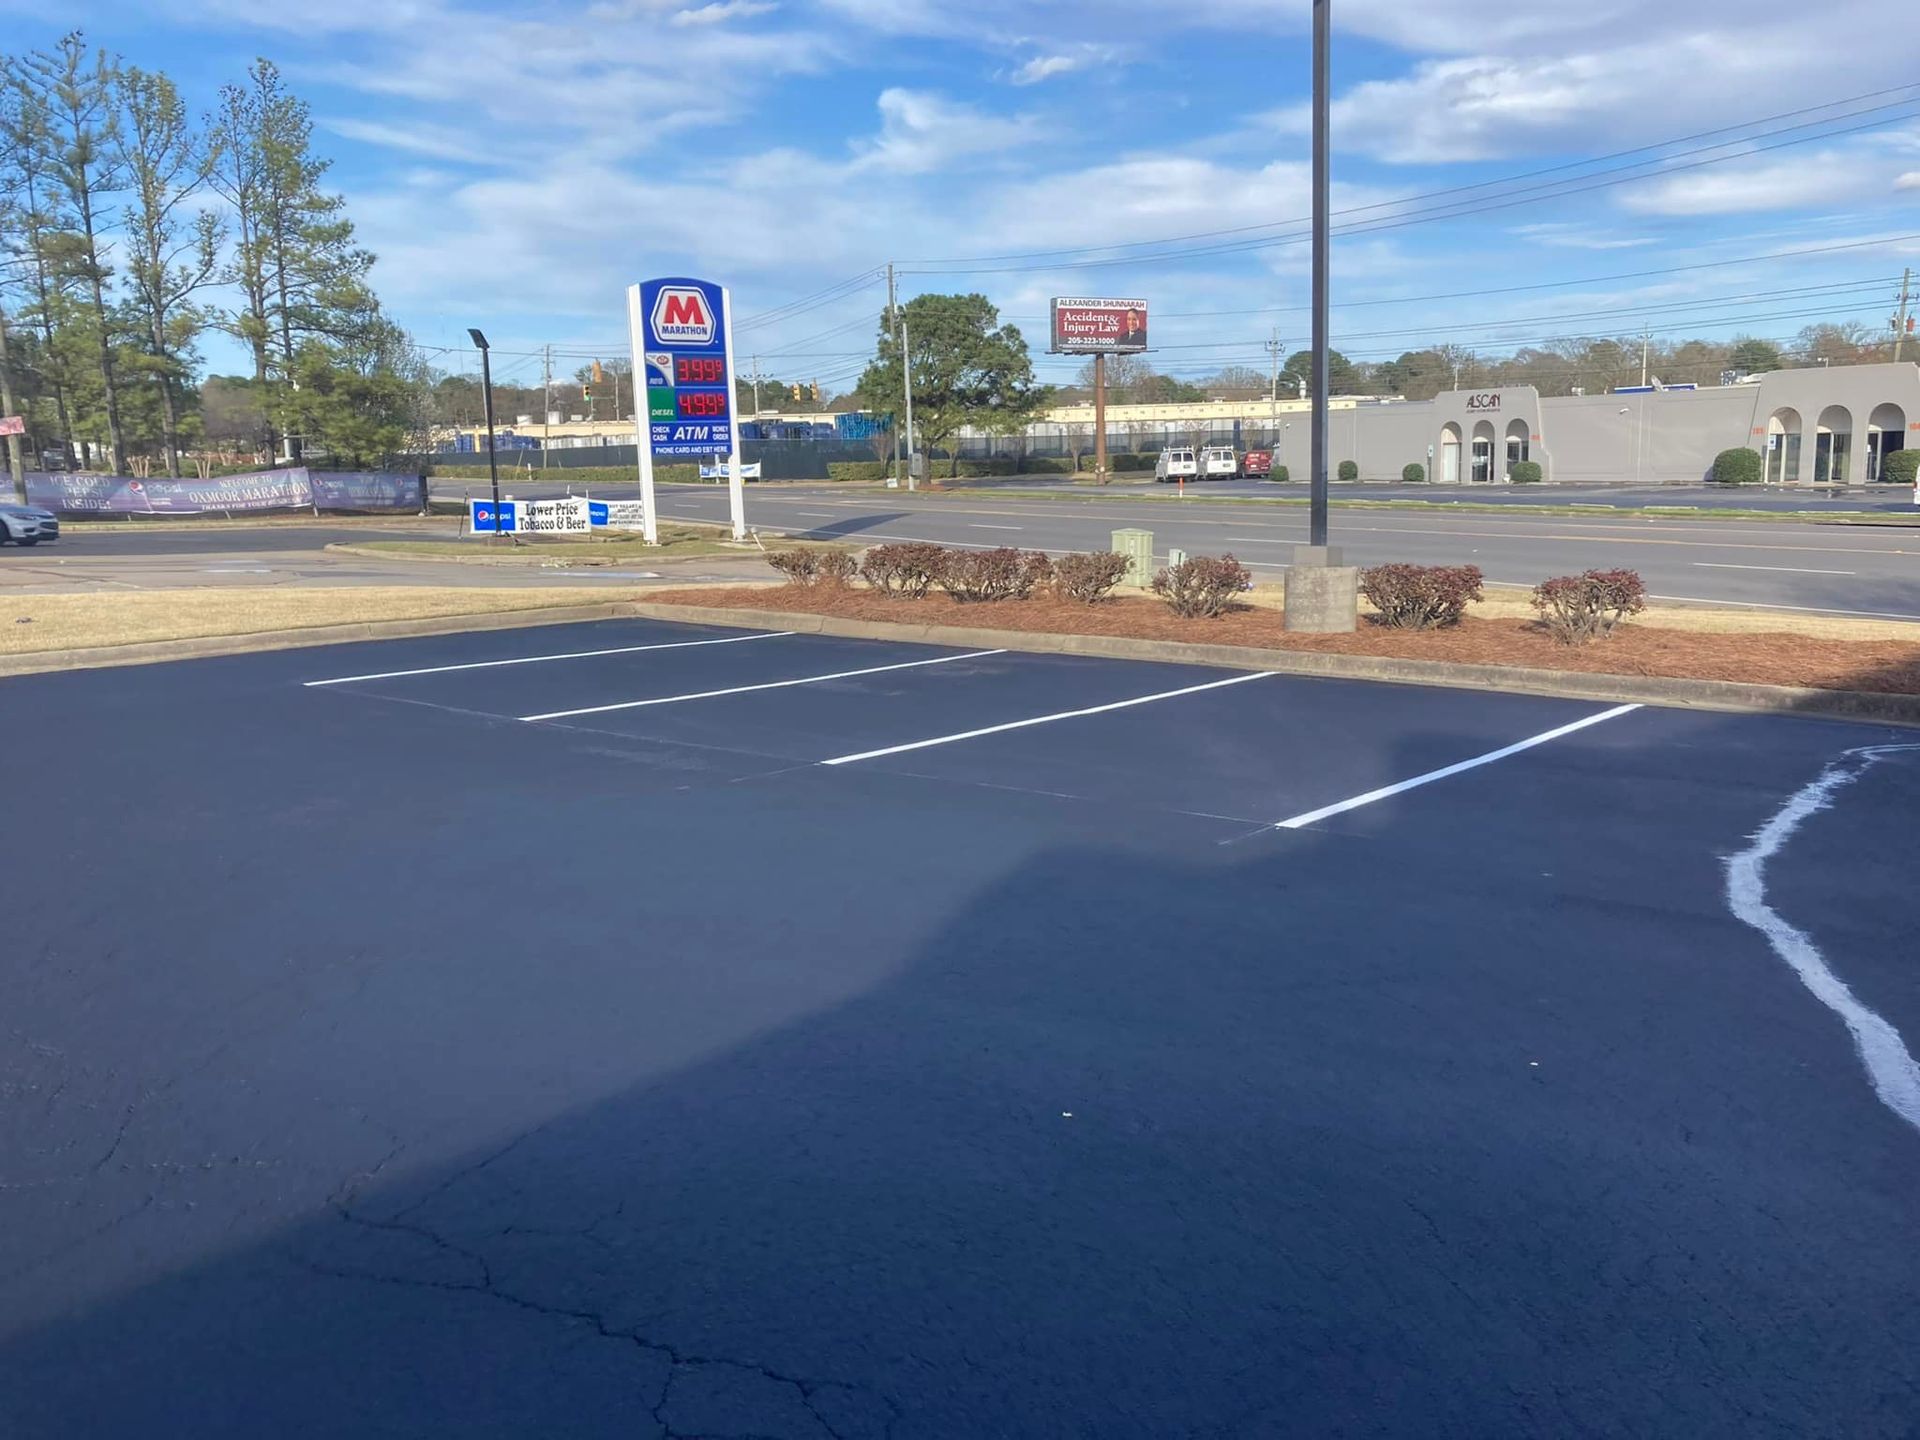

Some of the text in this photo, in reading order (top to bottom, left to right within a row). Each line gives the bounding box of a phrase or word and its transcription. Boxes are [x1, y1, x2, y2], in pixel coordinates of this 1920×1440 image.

[1060, 299, 1145, 308] ALEXANDER SHUNNARAH
[1063, 311, 1120, 325] Accident &
[661, 325, 708, 335] MARATHON
[1063, 322, 1120, 334] Injury Law
[651, 408, 674, 416] DIESEL
[673, 426, 709, 440] ATM
[712, 433, 729, 441] ORDER
[655, 446, 674, 454] PHONE
[713, 445, 728, 453] HERE
[50, 475, 110, 488] ICE COLD
[219, 477, 258, 488] WELCOME
[189, 491, 241, 503] OXMOOR
[242, 482, 308, 501] MARATHON
[526, 503, 579, 516] Lower Price
[519, 516, 586, 531] Tobacco & Beer
